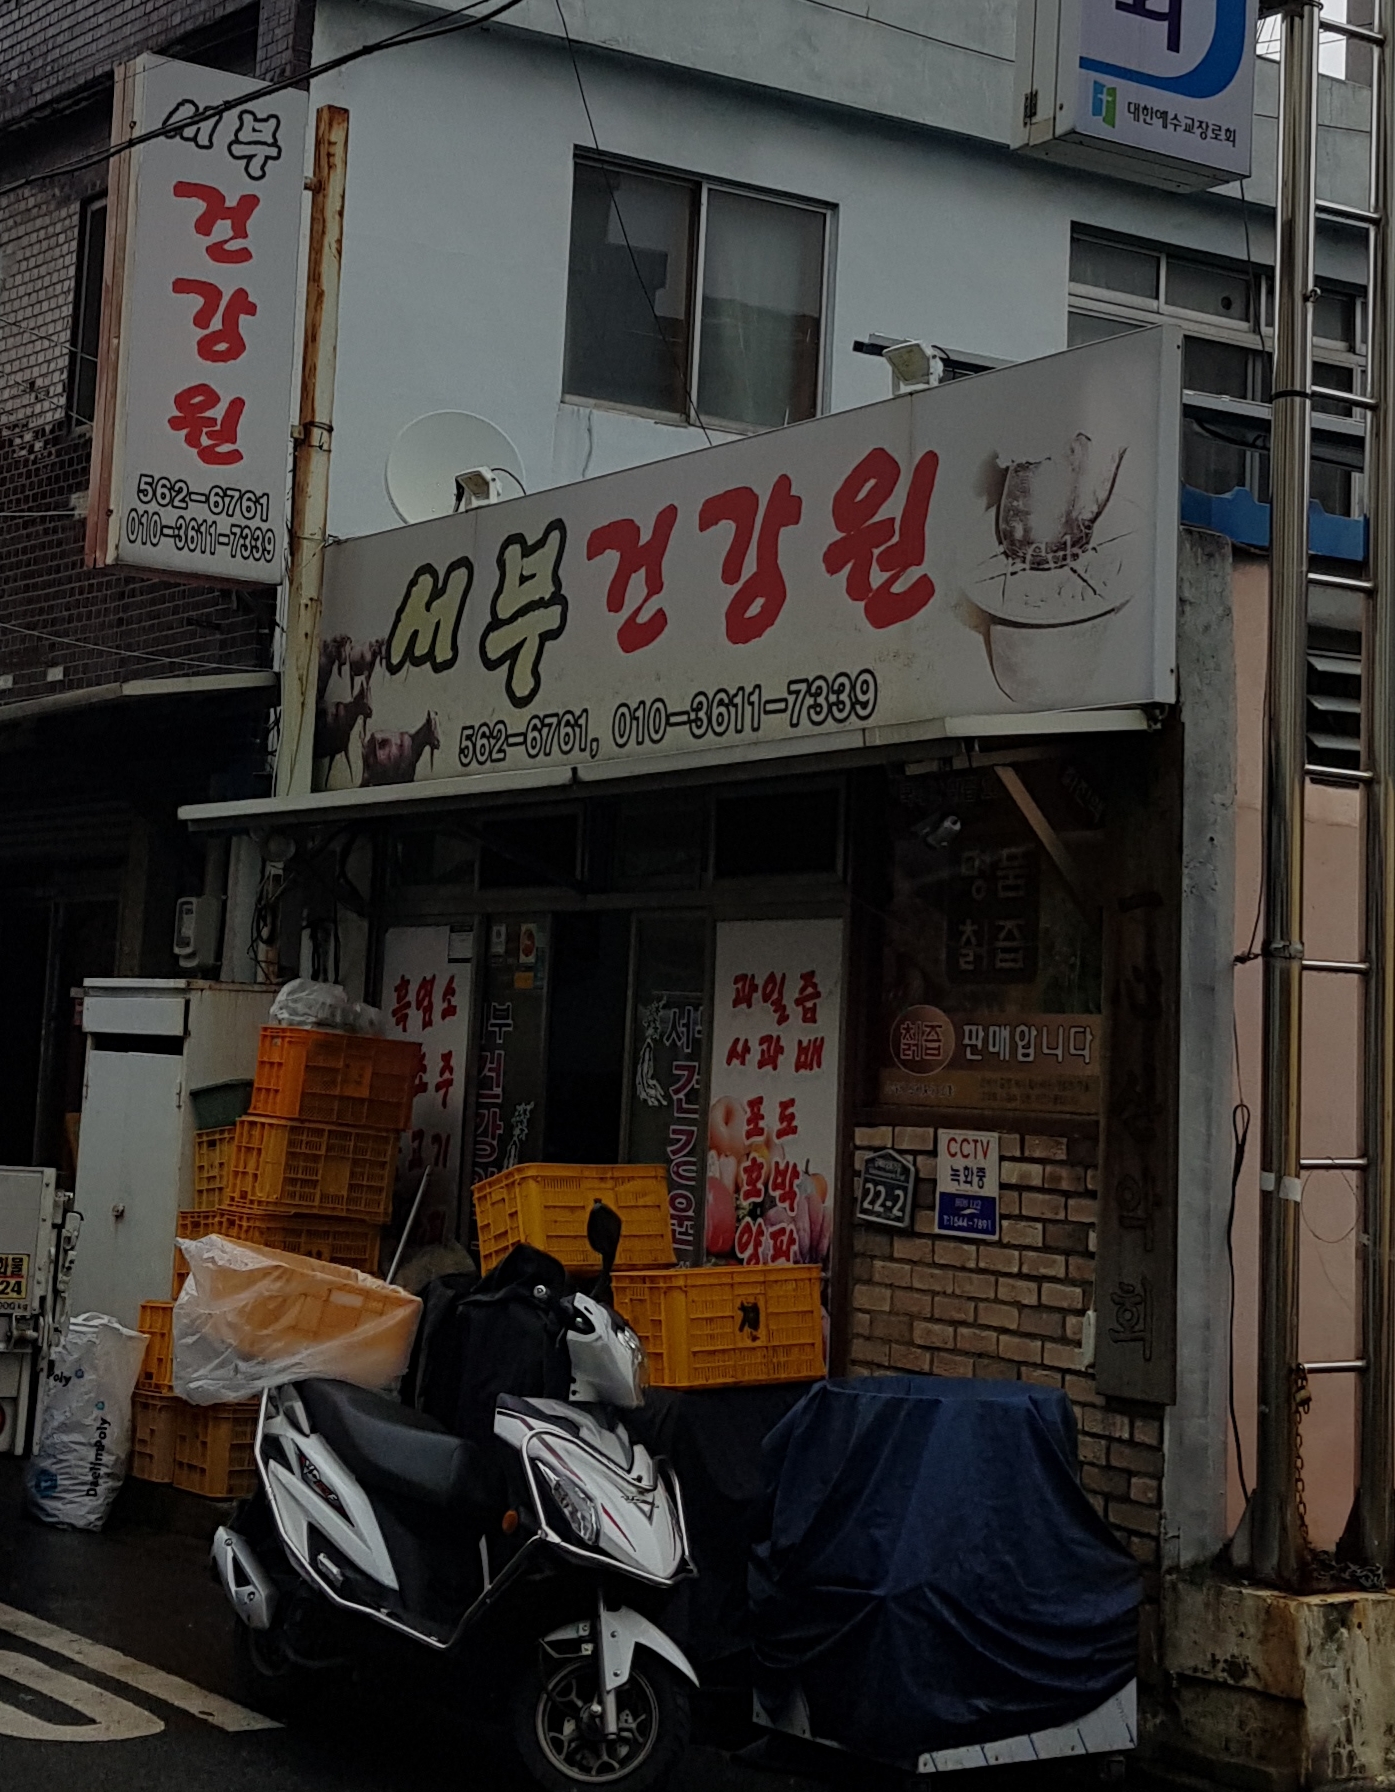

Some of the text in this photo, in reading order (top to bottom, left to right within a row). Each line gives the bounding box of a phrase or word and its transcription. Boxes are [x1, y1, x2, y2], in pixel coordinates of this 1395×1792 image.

[1126, 101, 1237, 148] 대한예수교장로회
[167, 181, 260, 466] 건강원
[137, 474, 271, 523] 562-6761
[127, 508, 277, 564] 010-3611-7339
[386, 447, 939, 708] 서부 건강원
[459, 667, 878, 767] 562-6761, 010-3611-7339
[391, 973, 458, 1033] 흑염소
[732, 970, 821, 1026] 과일즙
[900, 1020, 1094, 1065] 칡즙 판매합니다
[745, 1096, 798, 1140] 포도
[947, 1137, 990, 1159] CCTV
[743, 1156, 800, 1213] 호박
[863, 1183, 905, 1217] 22-2
[950, 1165, 986, 1190] 녹화중
[736, 1217, 798, 1266] 양파
